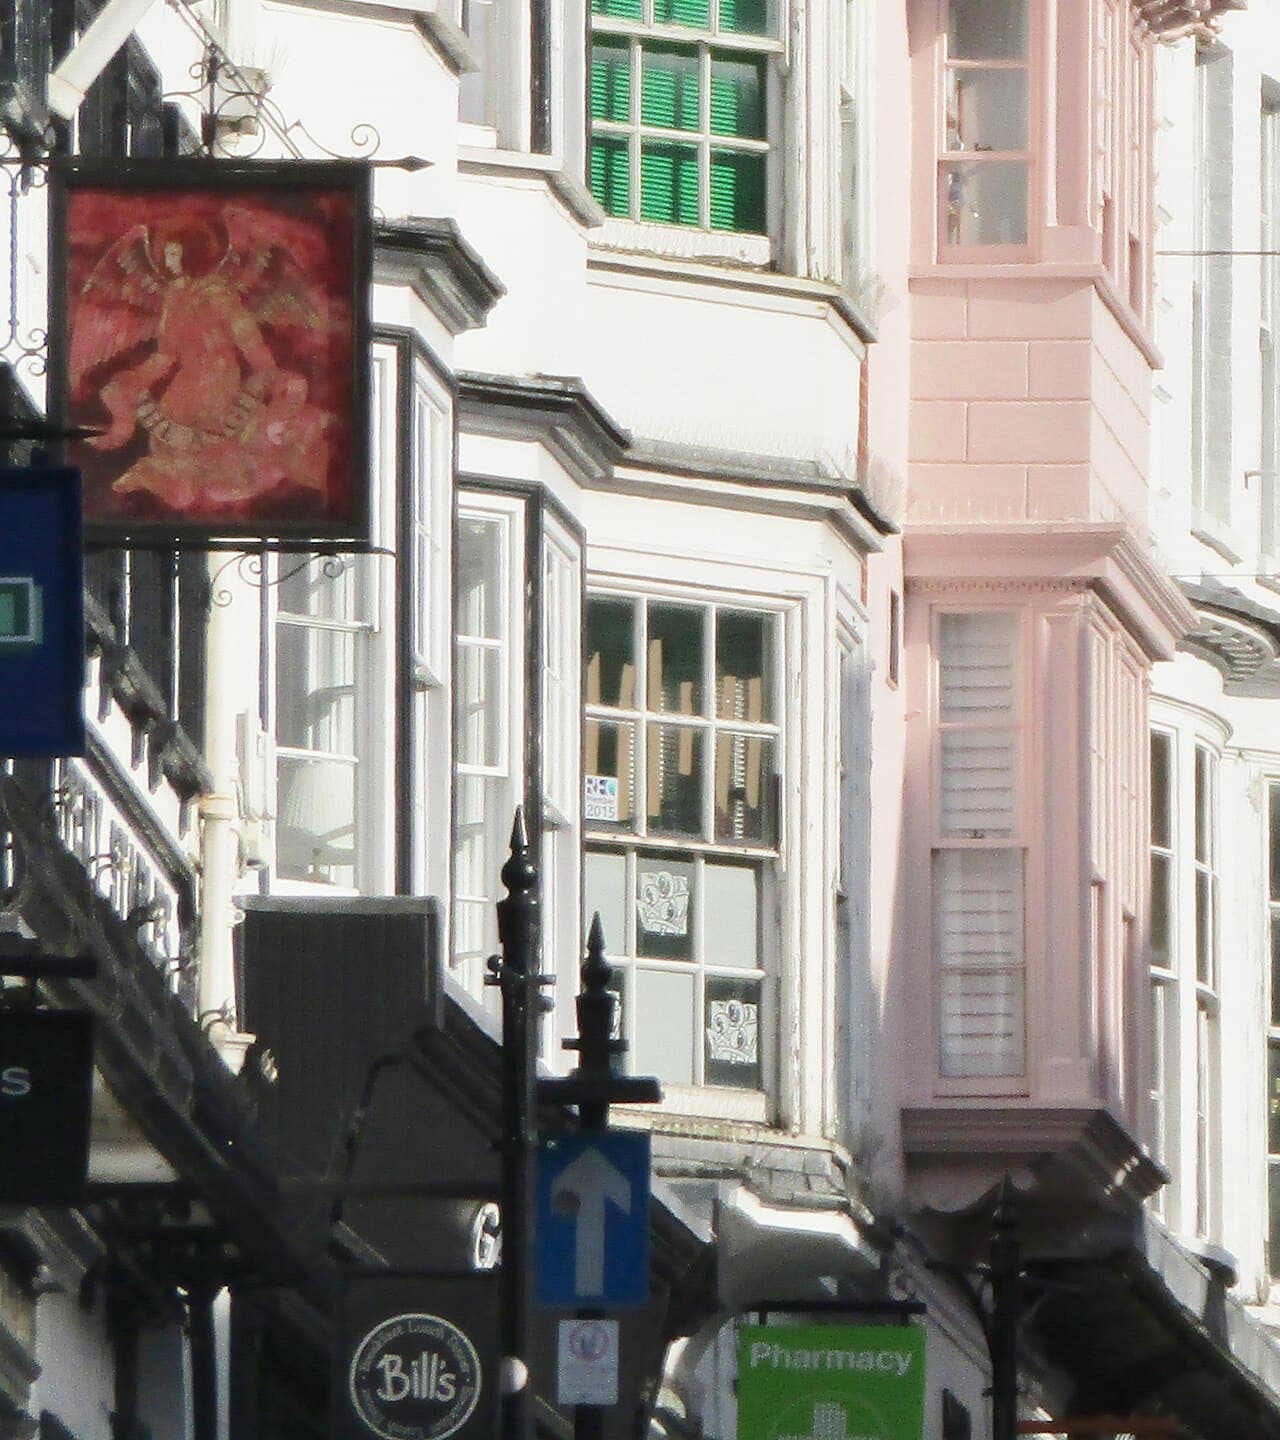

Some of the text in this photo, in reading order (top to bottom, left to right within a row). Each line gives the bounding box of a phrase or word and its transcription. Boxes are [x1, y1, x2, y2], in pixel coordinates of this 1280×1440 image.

[587, 804, 615, 819] 2015
[750, 1342, 912, 1376] Pharmacy
[376, 1351, 457, 1402] Bill's
